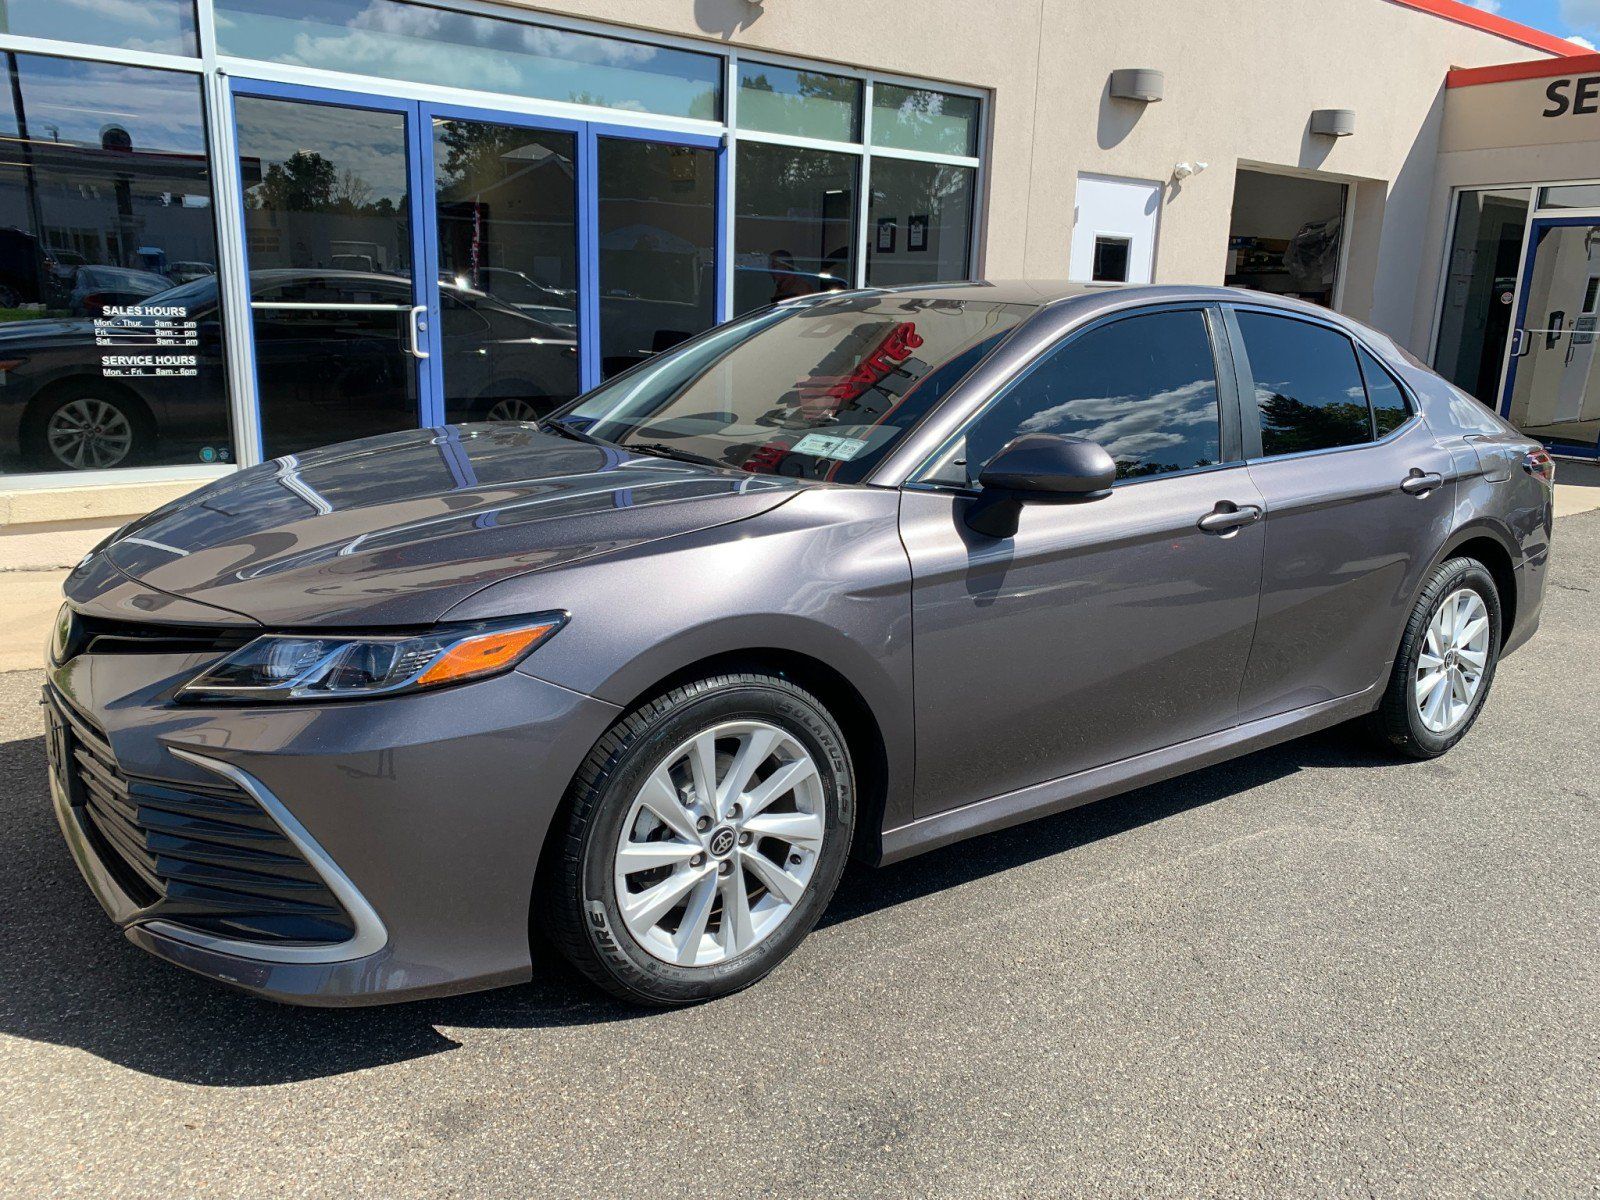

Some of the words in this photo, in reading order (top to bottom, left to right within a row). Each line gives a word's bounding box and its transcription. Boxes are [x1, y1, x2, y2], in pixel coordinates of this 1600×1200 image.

[1542, 77, 1600, 118] SE
[102, 305, 142, 316] SALES
[145, 306, 187, 316] HOURS
[93, 319, 115, 327] Mon.
[122, 319, 143, 327] Thur.
[154, 319, 172, 327] 9am
[94, 328, 109, 336] Fri.
[95, 337, 113, 345] Sat.
[156, 337, 174, 345] 9am
[102, 355, 153, 366] SERVICE
[155, 355, 197, 366] HOURS
[102, 368, 124, 376] Mon.
[778, 701, 845, 773] SOLARUS
